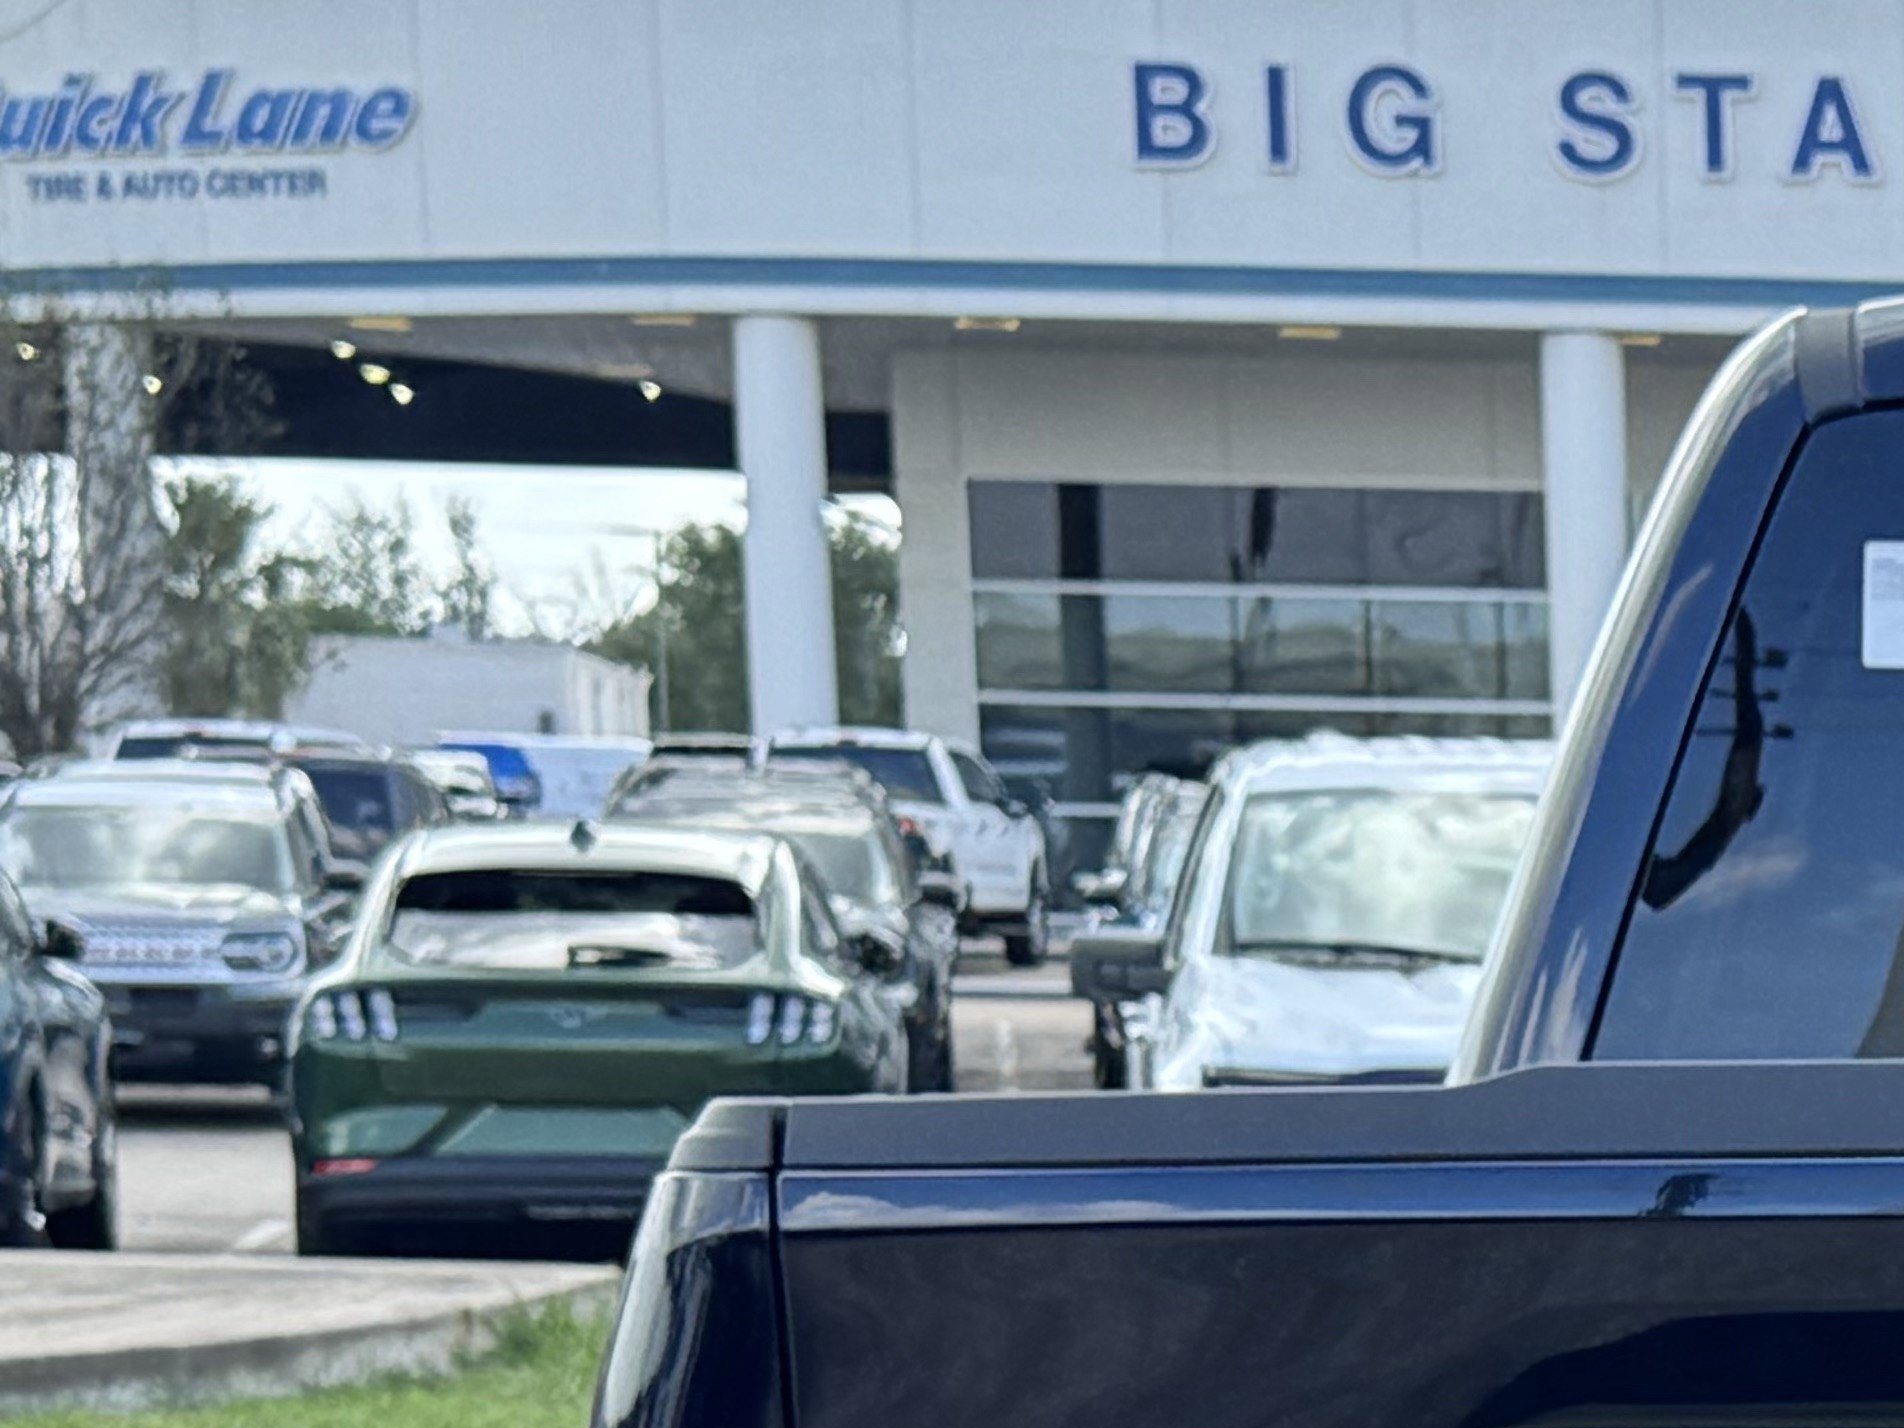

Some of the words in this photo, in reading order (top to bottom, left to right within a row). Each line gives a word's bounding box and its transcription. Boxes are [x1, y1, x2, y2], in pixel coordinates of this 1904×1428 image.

[0, 68, 172, 152] uick
[180, 67, 412, 150] Lane
[1133, 62, 1435, 172] BIG
[27, 173, 84, 201] TIRE
[122, 170, 201, 200] AUTO
[205, 166, 327, 198] CENTER
